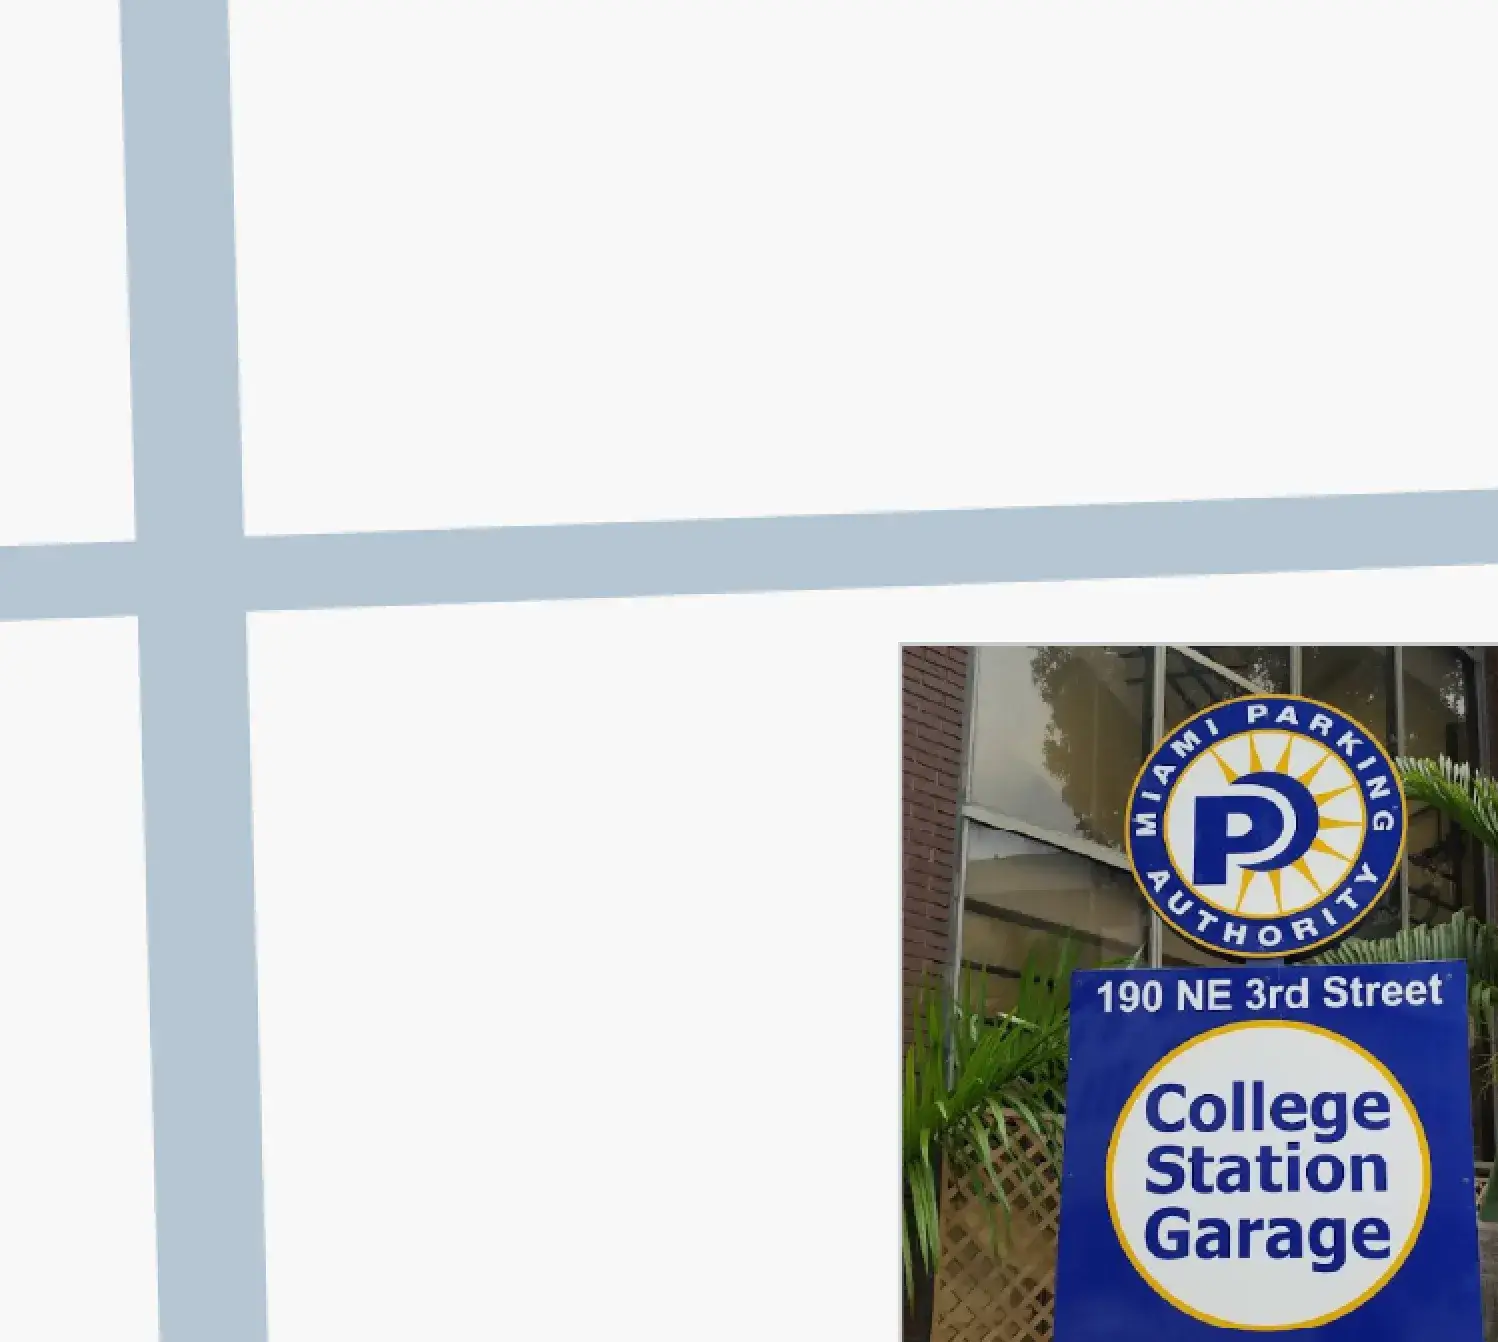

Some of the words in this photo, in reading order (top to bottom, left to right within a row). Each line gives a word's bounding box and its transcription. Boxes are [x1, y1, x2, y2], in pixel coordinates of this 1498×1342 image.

[1134, 718, 1219, 837] MIAMI
[1246, 704, 1395, 831] PARKING
[1146, 862, 1379, 947] AUTHORITY
[1097, 979, 1163, 1013] 190
[1177, 979, 1232, 1011] NE
[1245, 977, 1309, 1009] 3rd
[1323, 973, 1443, 1008] Street
[1144, 1080, 1391, 1143] College
[1144, 1142, 1388, 1195] Station
[1144, 1205, 1391, 1273] Garage
